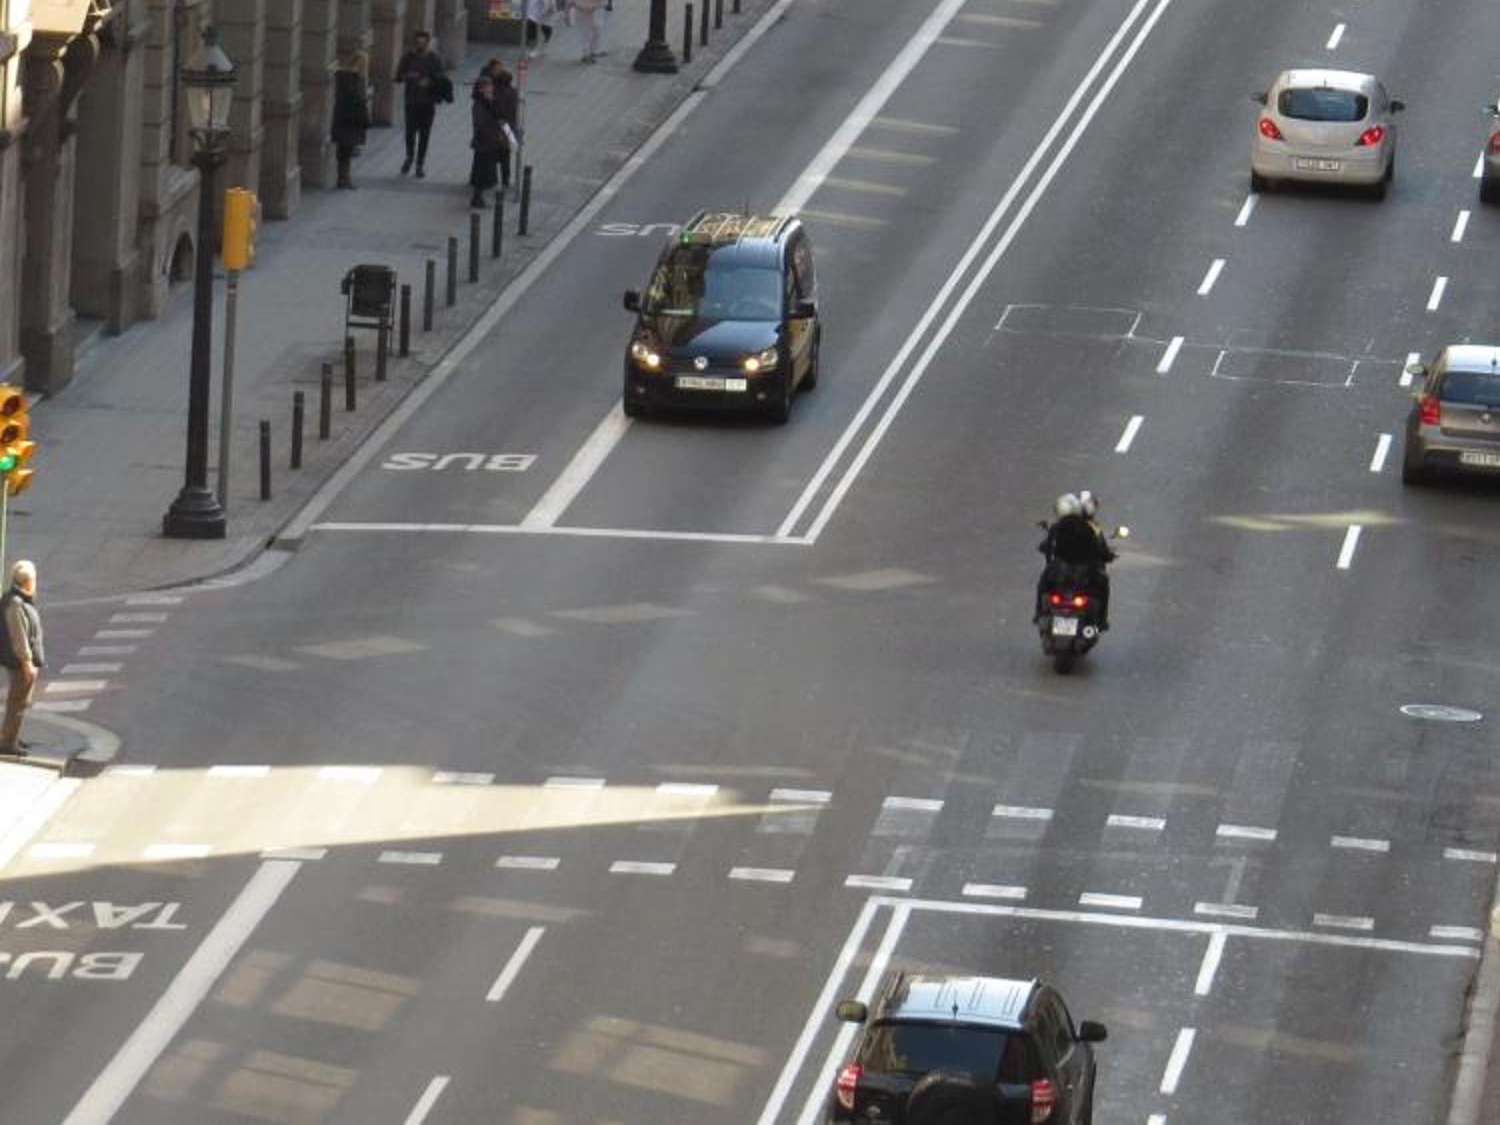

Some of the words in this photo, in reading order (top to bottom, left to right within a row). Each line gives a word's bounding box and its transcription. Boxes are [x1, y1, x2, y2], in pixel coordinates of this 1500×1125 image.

[594, 222, 681, 236] US
[381, 452, 539, 471] BUS
[0, 950, 145, 980] BU
